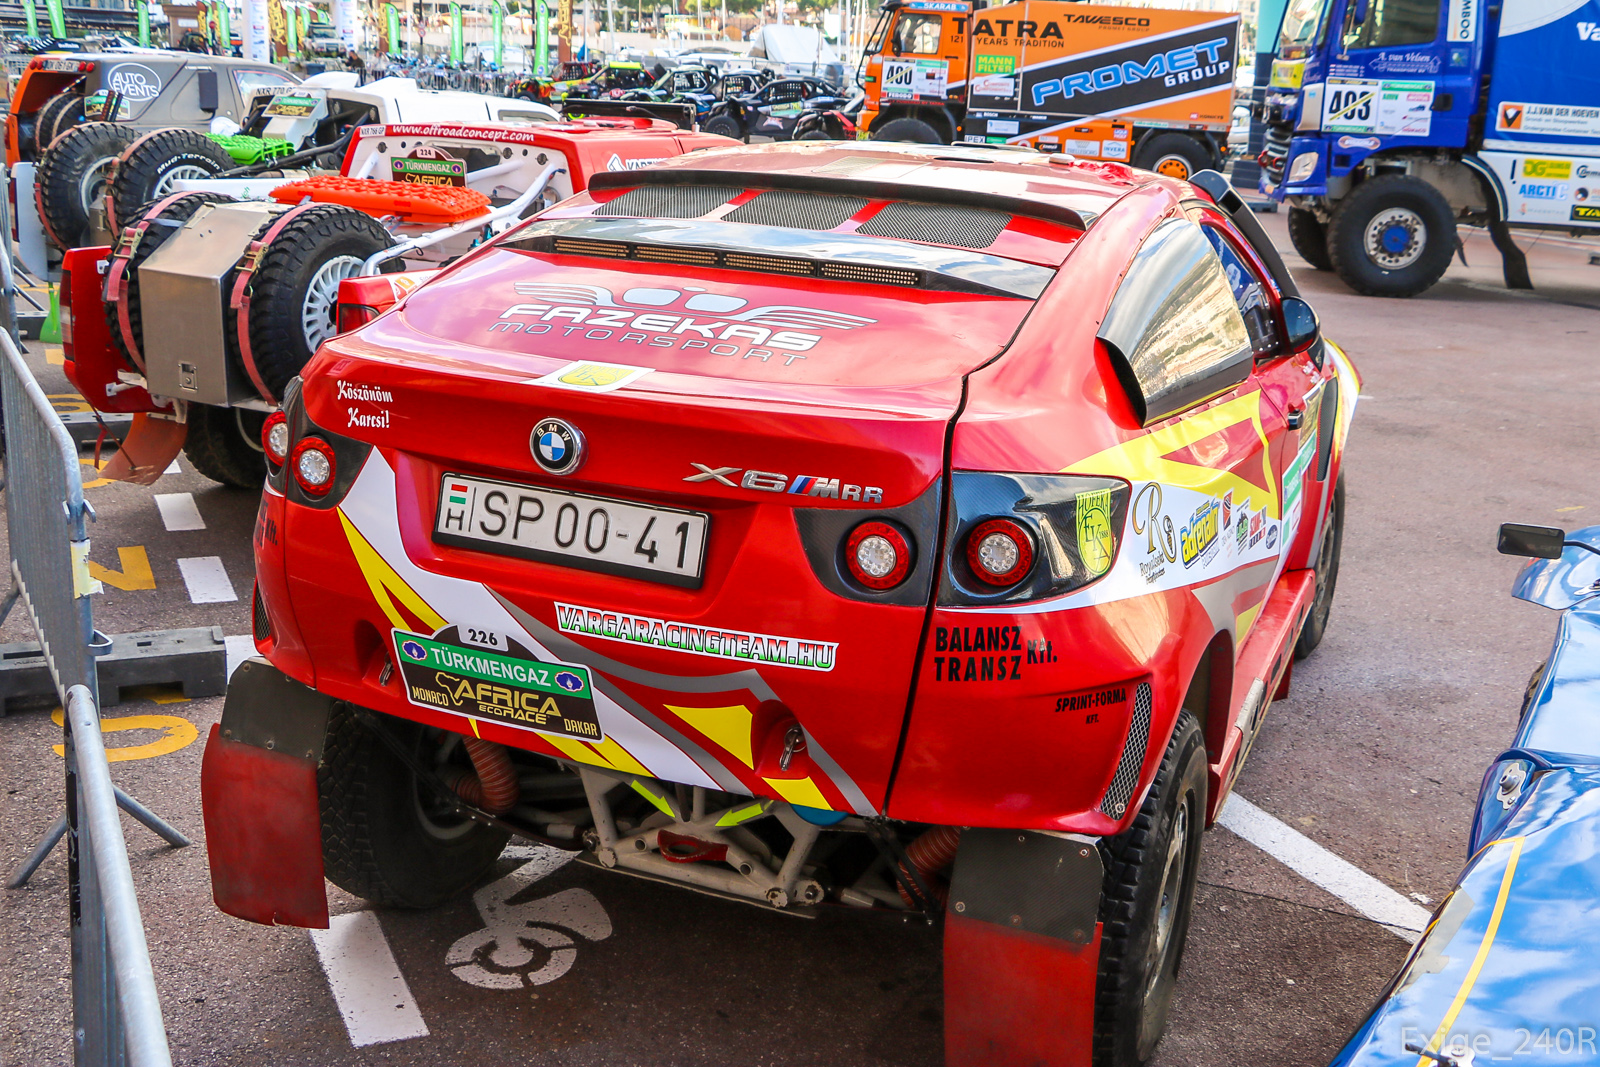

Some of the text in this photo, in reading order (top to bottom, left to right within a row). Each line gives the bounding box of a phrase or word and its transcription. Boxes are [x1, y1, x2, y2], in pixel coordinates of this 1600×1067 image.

[952, 17, 1064, 39] TATRA
[1063, 13, 1150, 27] TAWESCO
[950, 35, 1065, 48] 121 YEARS TRADITION
[977, 64, 1013, 73] FILTER
[978, 56, 1013, 65] MANN
[112, 72, 147, 85] AUTO
[886, 65, 913, 85] 400
[1030, 37, 1229, 107] PROMET
[1164, 60, 1230, 87] GROUP
[113, 83, 160, 98] EVENTS
[256, 87, 271, 95] NXR
[1328, 90, 1371, 121] 403
[1555, 107, 1569, 117] DER
[1570, 108, 1600, 118] HOEVEN
[361, 127, 370, 136] NXR
[377, 126, 385, 135] GP
[392, 124, 535, 142] www.offroadconcept.com
[404, 160, 451, 173] TÜRKMENGAZ
[499, 303, 822, 352] FAZEKAS
[486, 322, 808, 367] MOTORSPORT
[336, 379, 394, 403] Köszönöm
[347, 406, 390, 428] Karcsi!
[536, 423, 571, 442] BMW
[681, 461, 789, 493] X6
[467, 628, 498, 646] 226
[557, 604, 836, 669] VARGARACINGTEAM.HU
[935, 625, 1058, 664] BALANSZ Kft.
[430, 646, 551, 687] TÜRKMENGAZ
[934, 655, 1022, 682] TRANSZ
[453, 679, 562, 717] AFRICA
[1054, 688, 1127, 713] SPRINT-FORMA
[411, 685, 598, 737] MONACO DAKAR
[1085, 712, 1100, 725] KFT.
